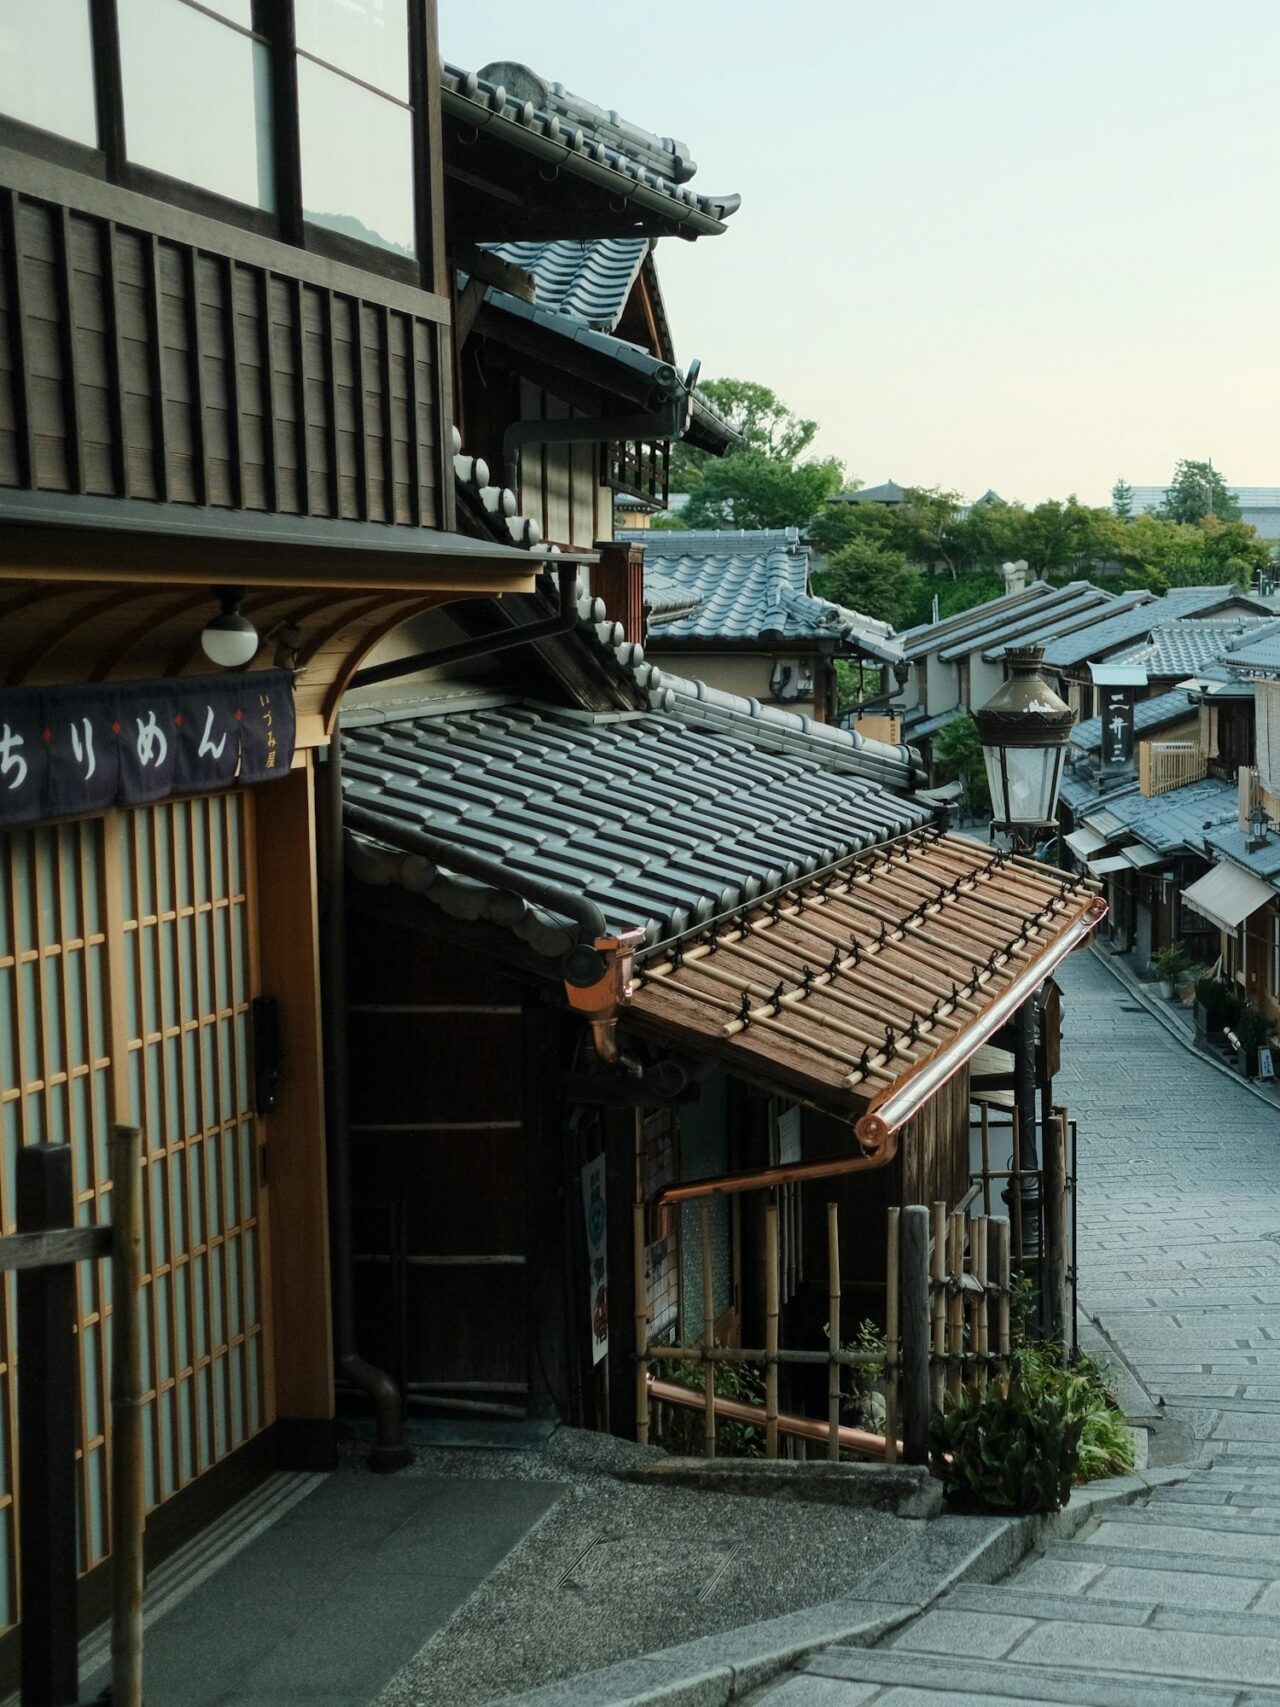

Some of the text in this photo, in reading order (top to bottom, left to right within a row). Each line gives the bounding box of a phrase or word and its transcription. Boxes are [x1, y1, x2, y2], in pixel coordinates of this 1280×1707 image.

[0, 705, 227, 790] ちりめん
[258, 694, 278, 768] いづみ屋
